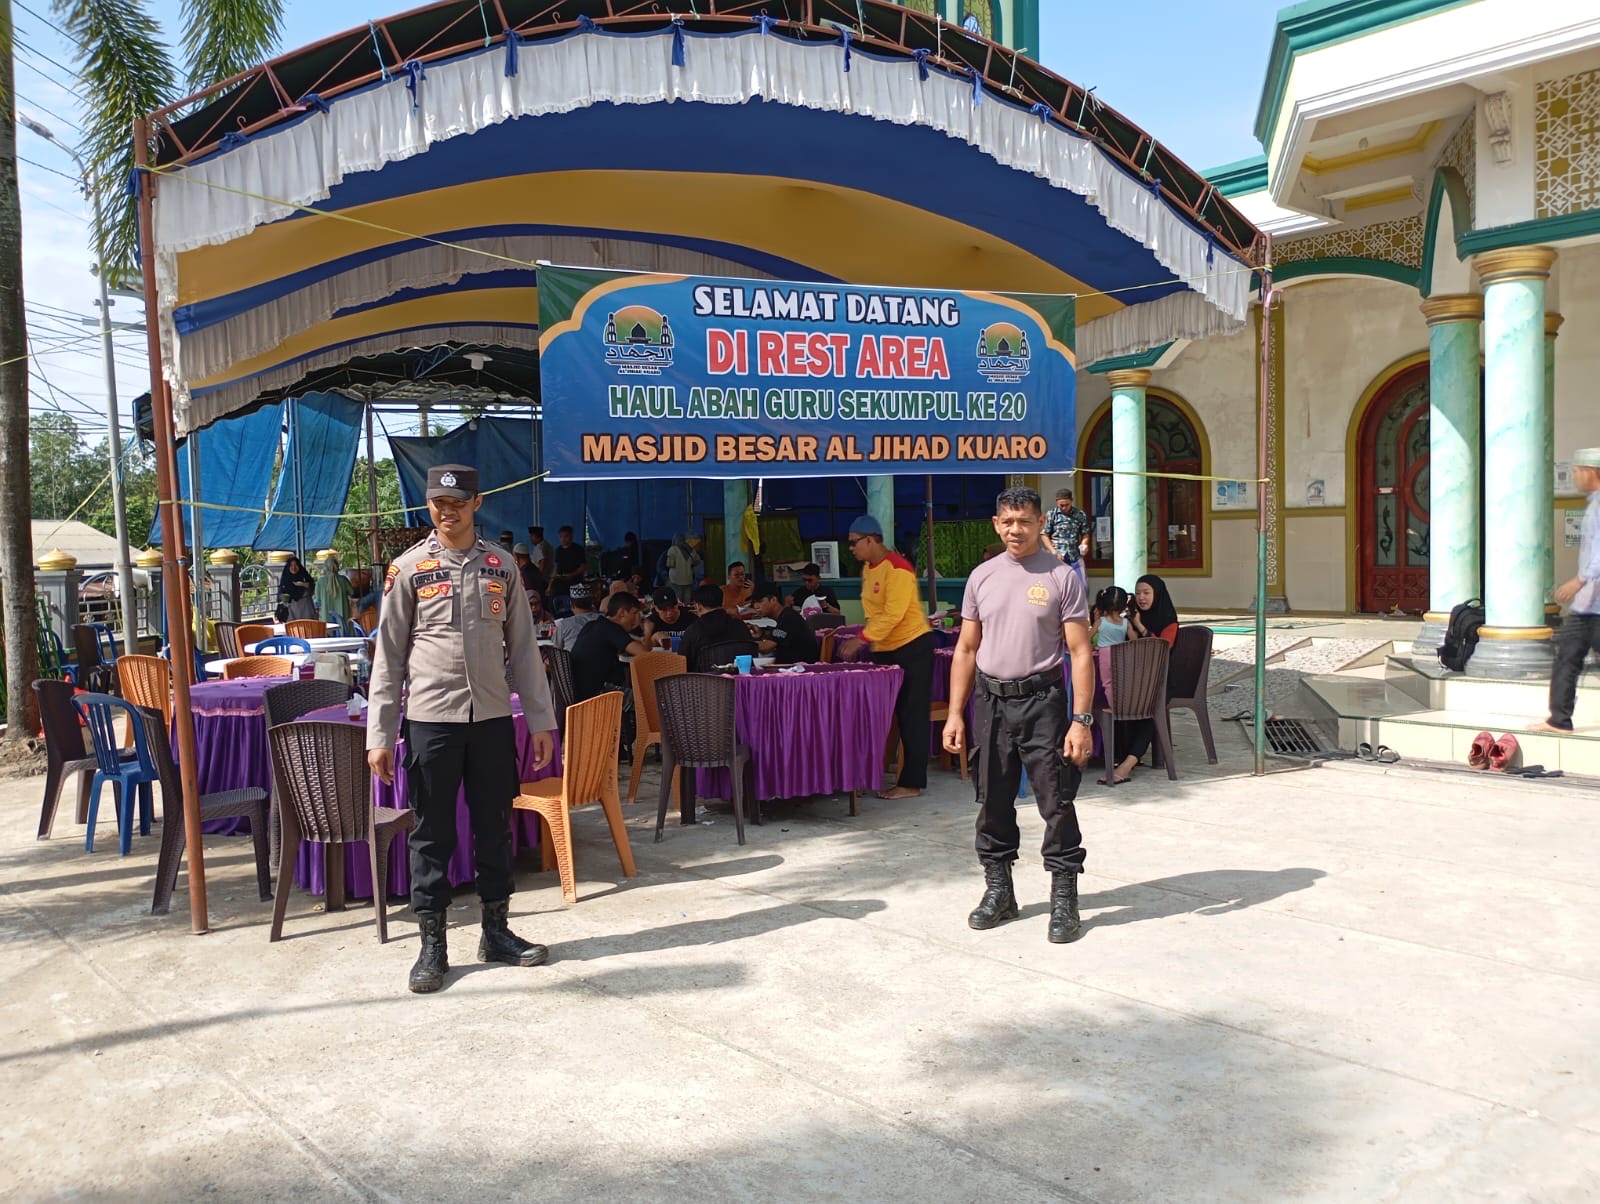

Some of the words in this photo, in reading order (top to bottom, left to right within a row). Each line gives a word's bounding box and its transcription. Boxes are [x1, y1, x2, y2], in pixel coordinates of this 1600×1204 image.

[693, 284, 840, 322] SELAMAT
[847, 292, 960, 327] DATANG
[707, 328, 749, 376] DI
[757, 329, 850, 377] REST
[856, 334, 950, 380] AREA
[608, 385, 682, 418] HAUL
[687, 387, 759, 419] ABAH
[765, 388, 835, 419] GURU
[838, 390, 963, 421] SEKUMPUL
[967, 391, 996, 421] KE
[999, 392, 1027, 421] 20
[582, 433, 708, 464] MASJID
[715, 435, 819, 463] BESAR
[825, 435, 863, 462] AL
[868, 434, 951, 462] JIHAD
[956, 434, 1049, 461] KUARO
[479, 567, 509, 580] POLRI
